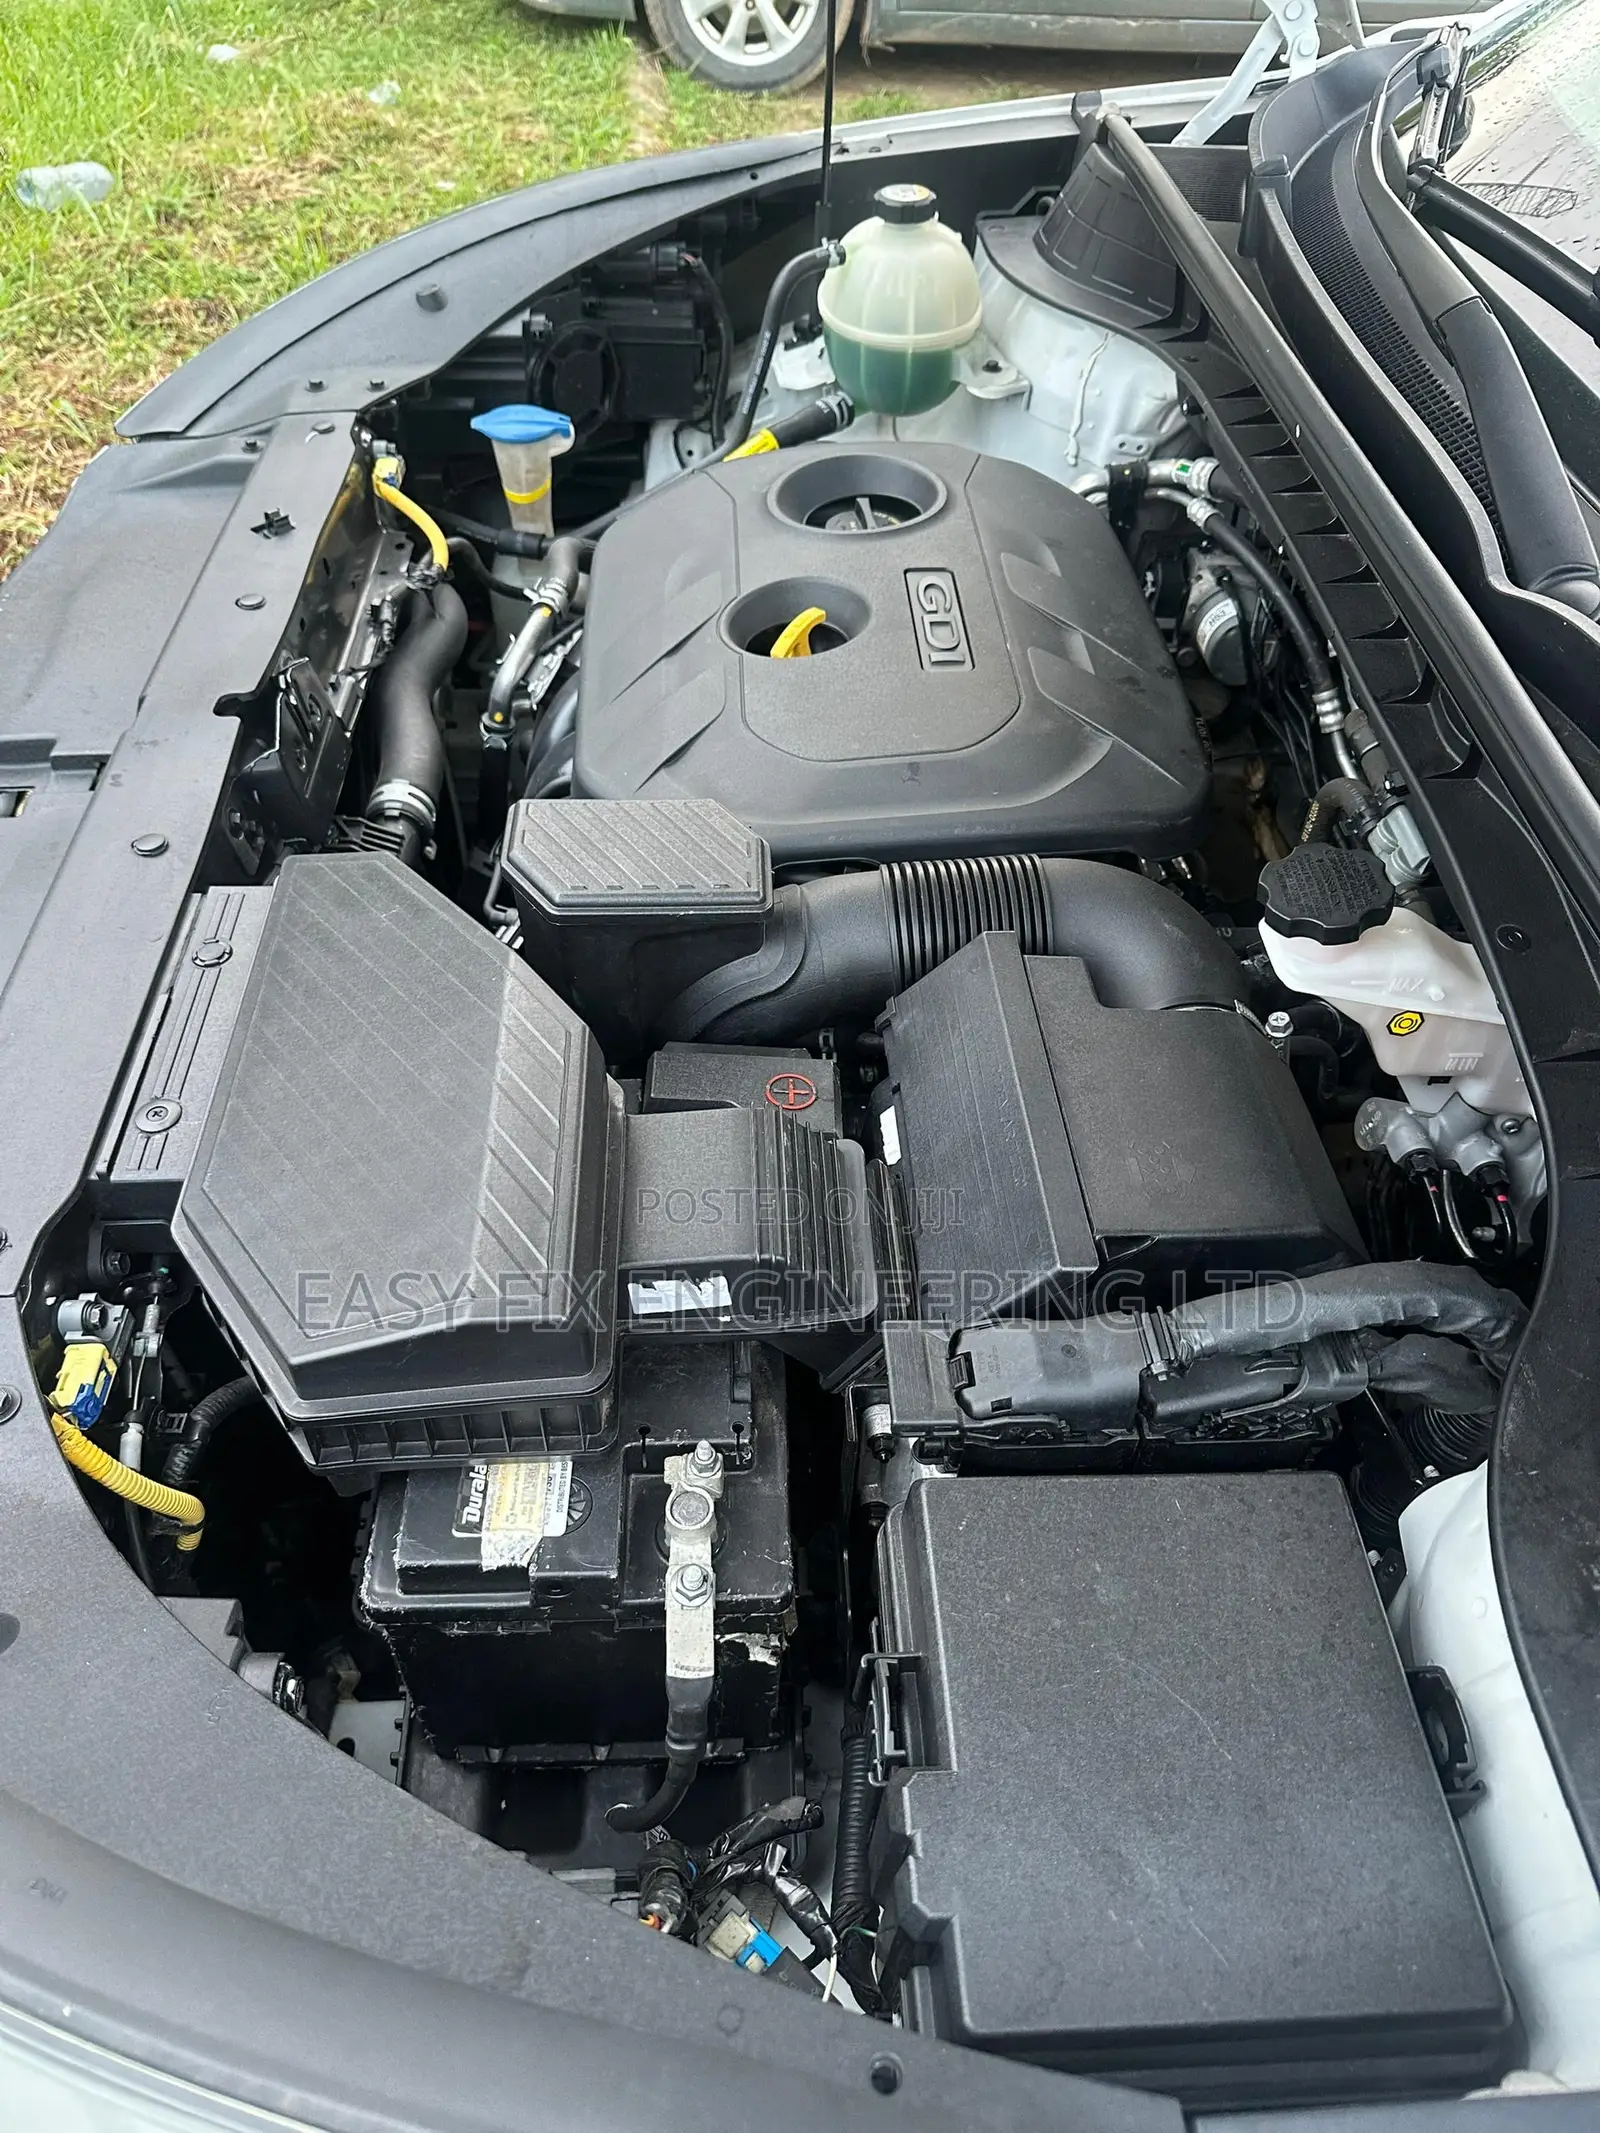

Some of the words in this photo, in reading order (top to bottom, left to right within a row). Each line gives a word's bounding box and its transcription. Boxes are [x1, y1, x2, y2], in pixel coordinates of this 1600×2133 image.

[917, 576, 965, 666] GDI
[1389, 978, 1425, 993] MAX
[1444, 1057, 1480, 1072] MIN
